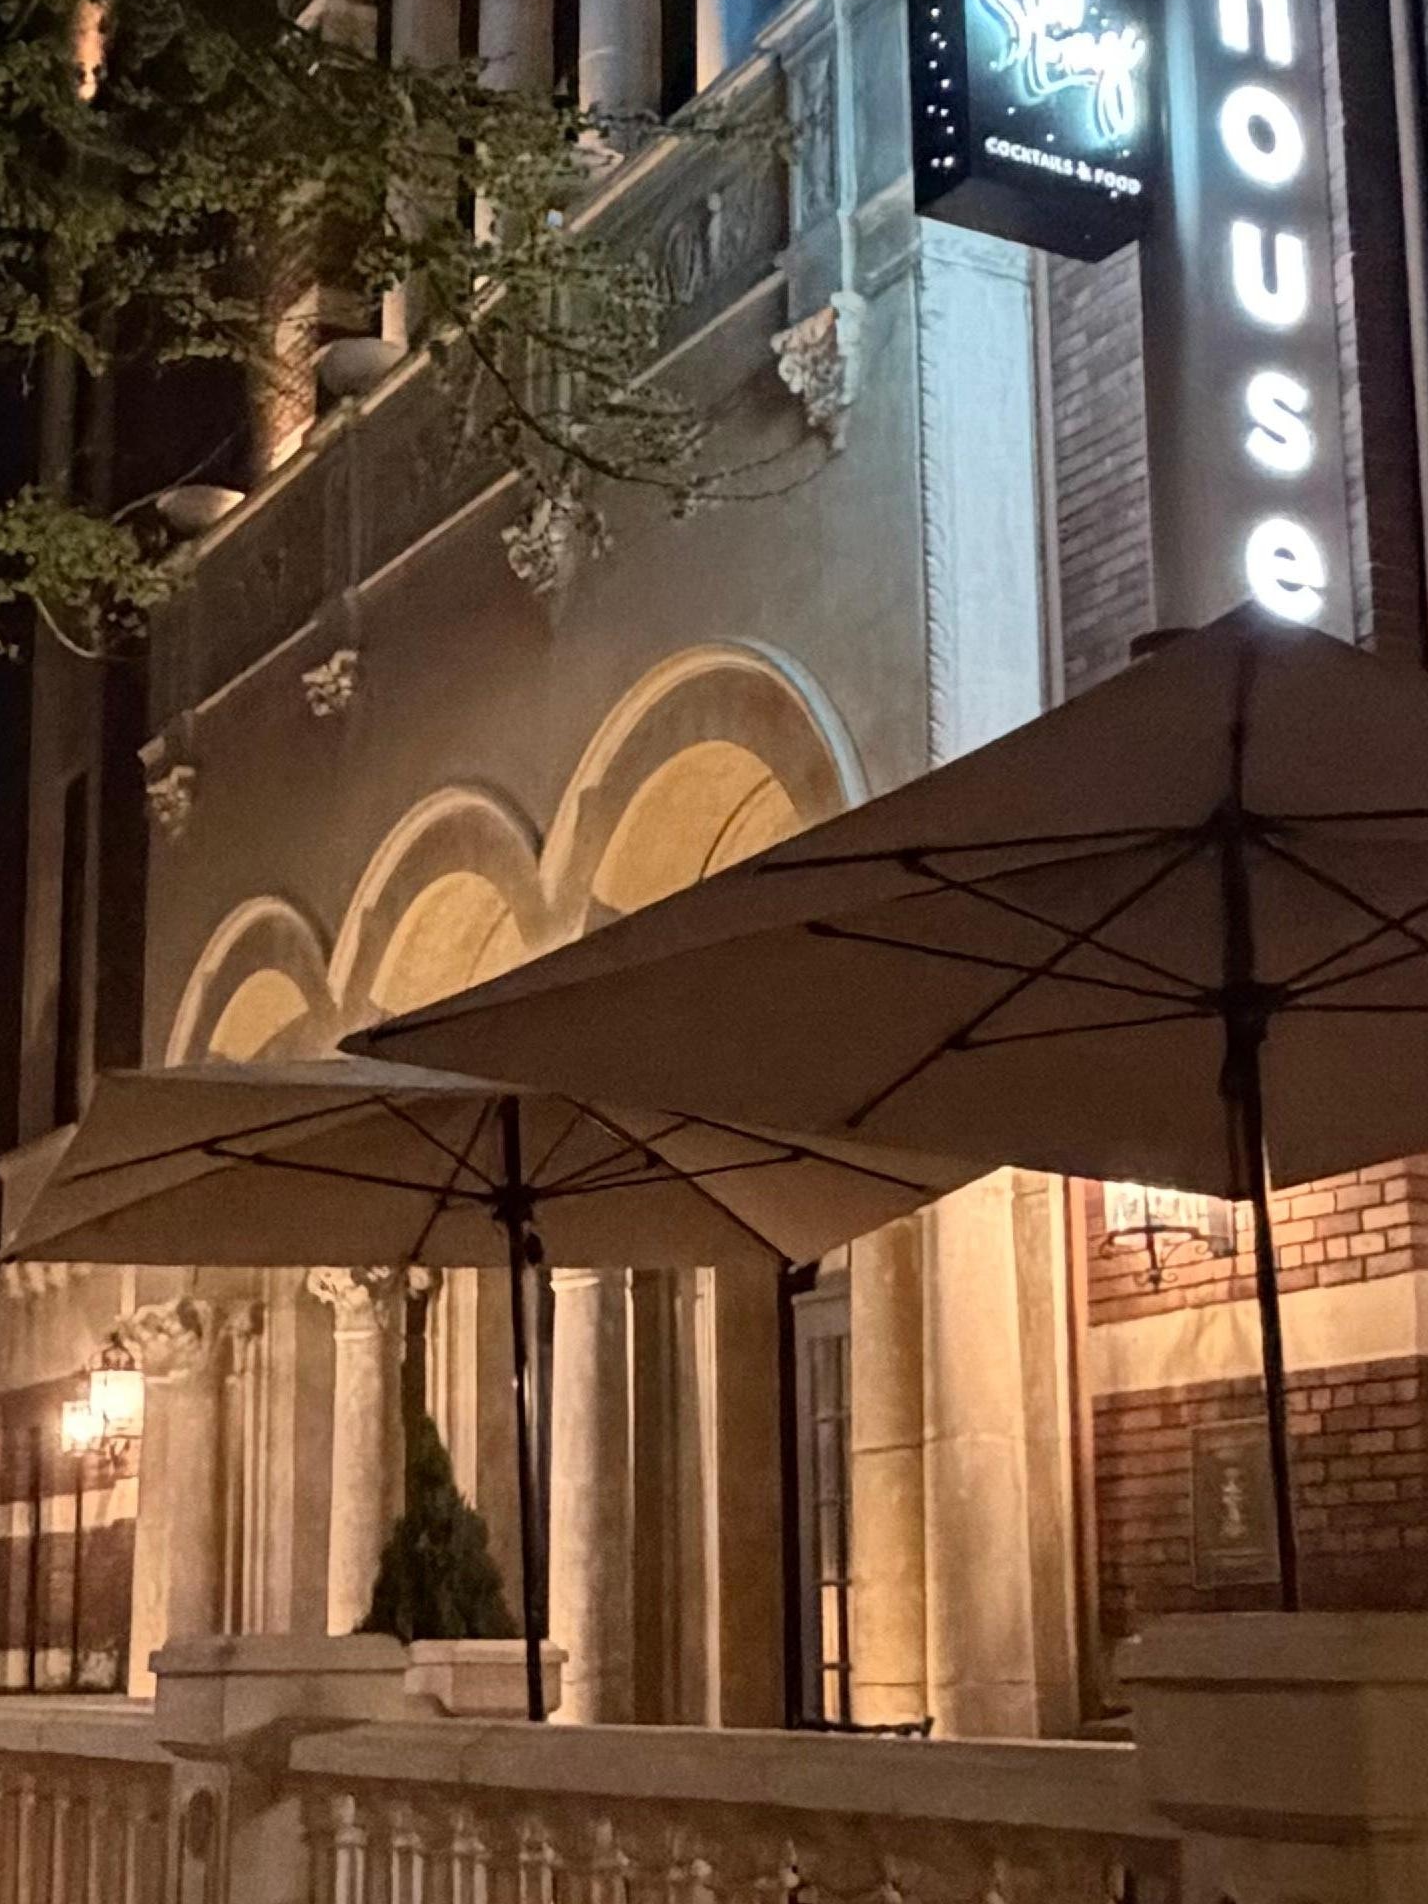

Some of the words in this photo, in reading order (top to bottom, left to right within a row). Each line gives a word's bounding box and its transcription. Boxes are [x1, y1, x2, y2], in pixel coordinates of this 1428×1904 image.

[984, 136, 1073, 176] COCKTAILS
[1076, 160, 1093, 182] &
[1094, 168, 1142, 195] FOOD
